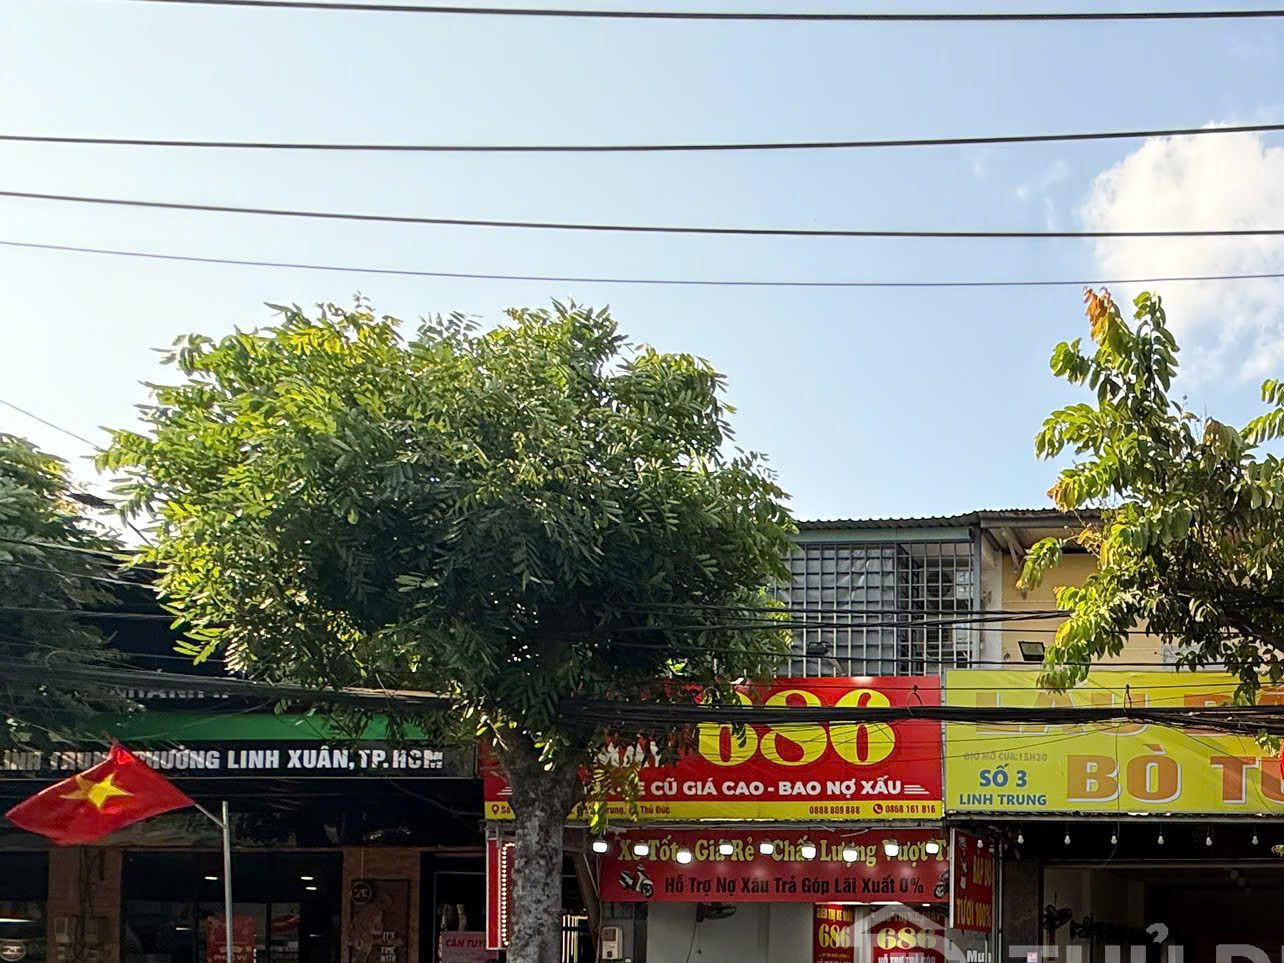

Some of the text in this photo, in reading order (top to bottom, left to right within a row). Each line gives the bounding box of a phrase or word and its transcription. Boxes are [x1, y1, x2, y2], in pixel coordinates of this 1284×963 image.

[227, 750, 279, 769] LINH
[979, 763, 1028, 788] SỐ 3
[1067, 744, 1182, 803] BÒ
[650, 777, 678, 796] CŨ
[682, 777, 716, 796] GIÁ
[721, 780, 765, 796] CAO
[778, 780, 821, 796] BAO
[826, 778, 857, 799] NỢ
[861, 775, 902, 796] XẤU
[959, 793, 1047, 806] LINH TRUNG
[819, 839, 878, 867] Lưng
[801, 874, 830, 896] Góp
[877, 927, 937, 951] 686
